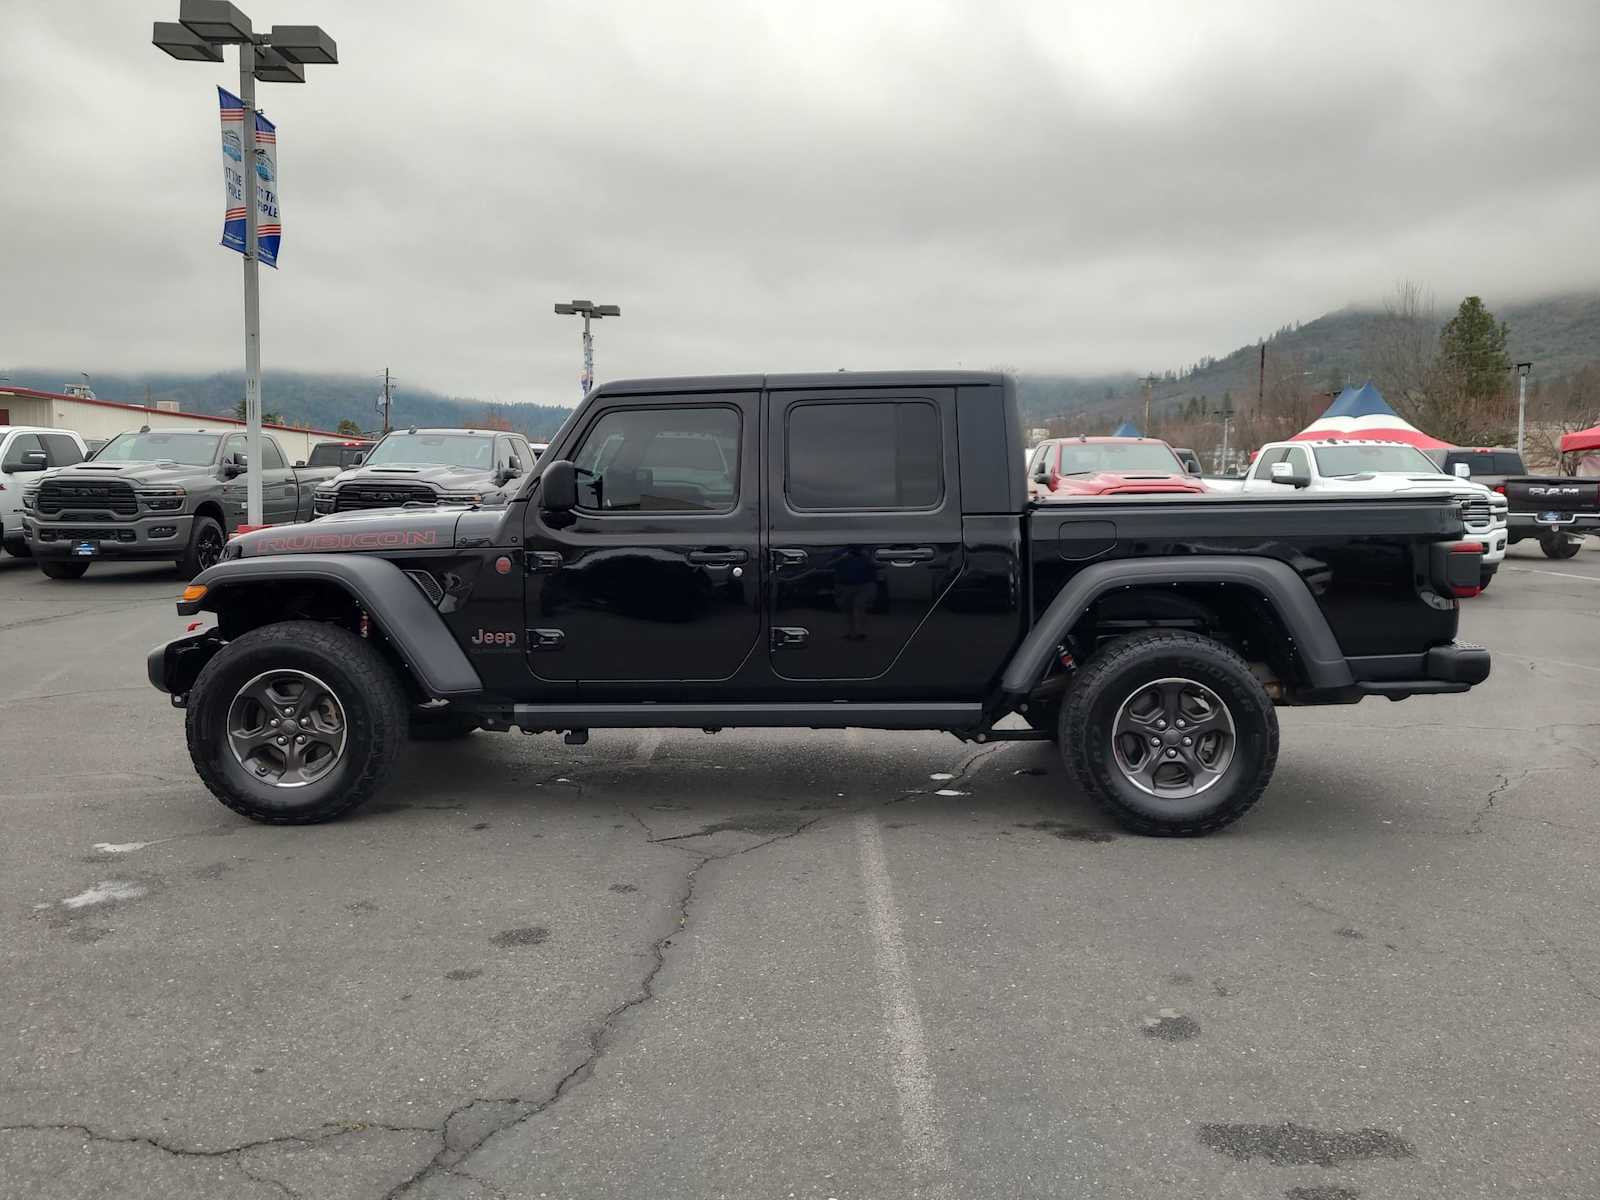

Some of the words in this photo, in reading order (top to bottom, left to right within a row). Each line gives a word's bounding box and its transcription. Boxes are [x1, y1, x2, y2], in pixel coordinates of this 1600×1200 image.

[1528, 487, 1580, 496] RAM
[255, 529, 439, 554] RUBICON
[471, 628, 518, 647] Jeep
